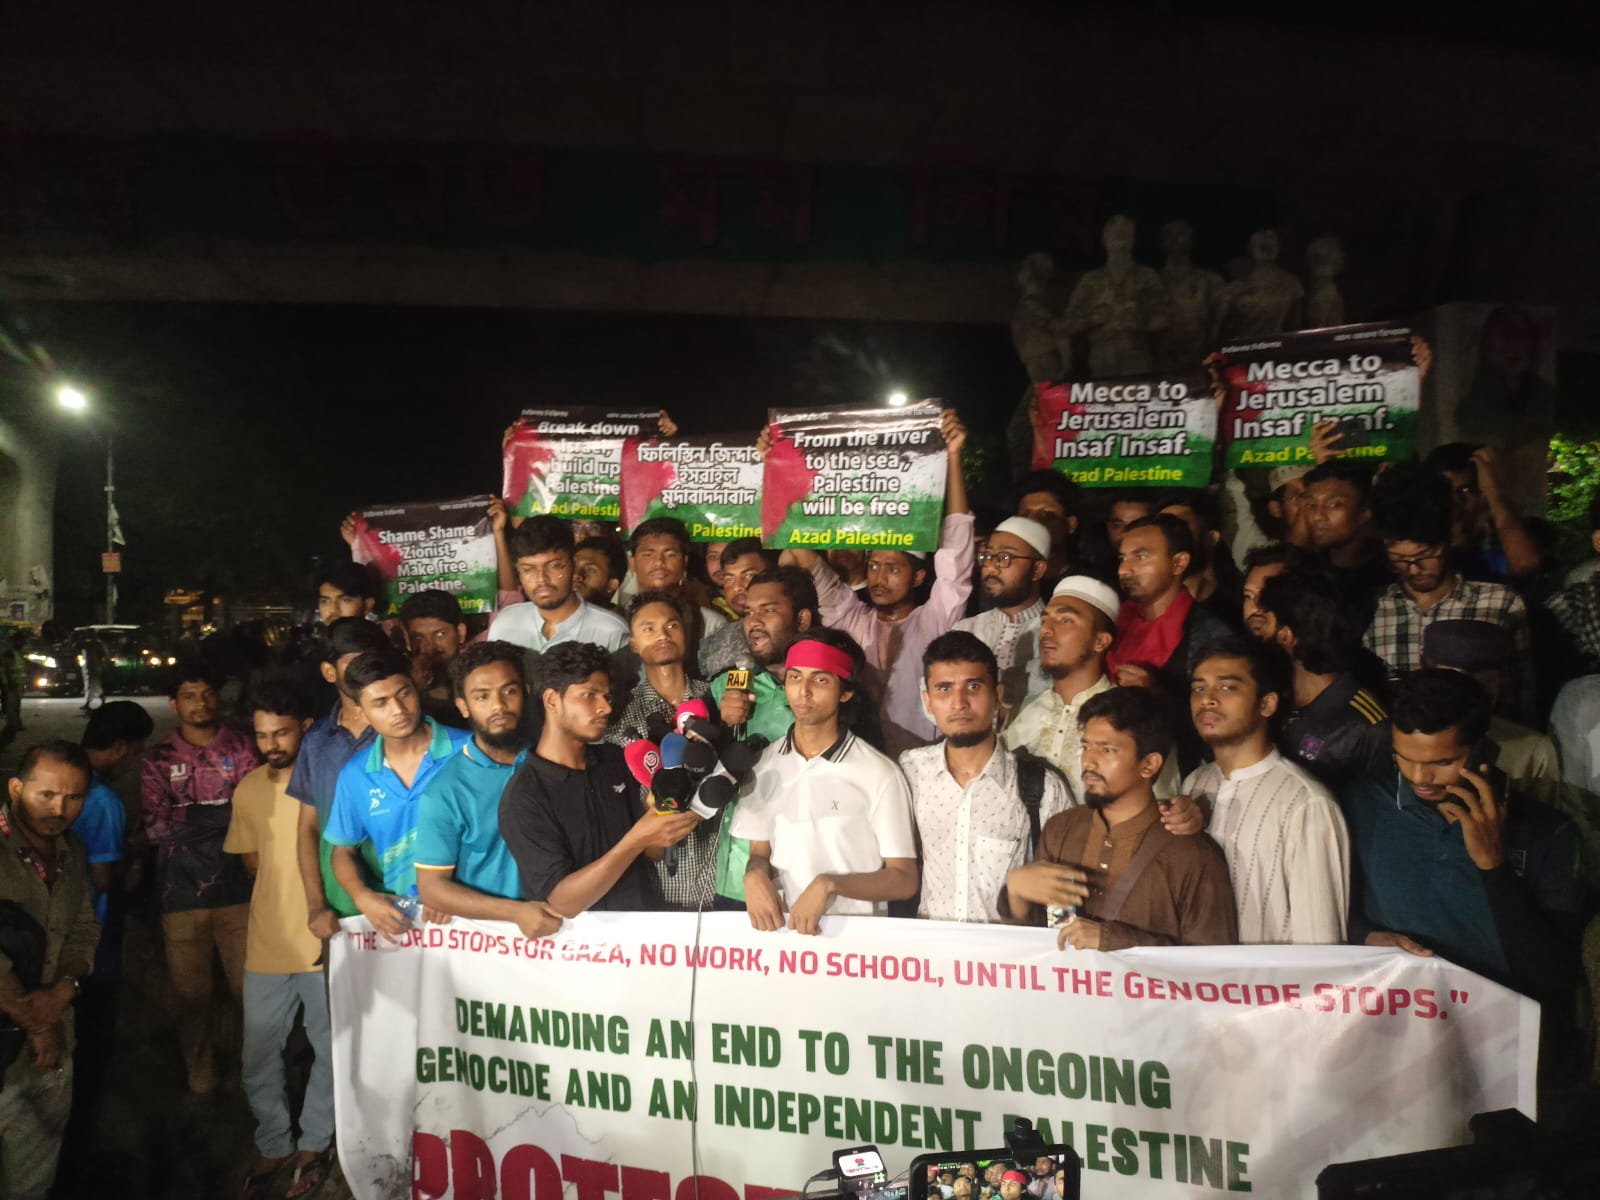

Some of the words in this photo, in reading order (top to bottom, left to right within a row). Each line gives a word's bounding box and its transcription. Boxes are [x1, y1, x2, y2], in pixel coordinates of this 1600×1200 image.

[1247, 358, 1341, 382] Mecca
[1348, 354, 1383, 373] to
[1070, 382, 1150, 403] Mecca
[1158, 381, 1187, 400] to
[1236, 382, 1384, 410] Jerusalem
[537, 421, 586, 433] Break
[590, 421, 639, 435] down
[1056, 407, 1185, 430] Jerusalem
[1234, 412, 1305, 439] Insaf
[793, 431, 842, 448] From
[846, 429, 878, 447] the
[882, 429, 931, 445] river
[1055, 435, 1116, 458] Insaf
[1120, 432, 1193, 456] Insaf.
[637, 443, 705, 462] ফিলিস্তিন
[805, 455, 826, 470] to
[829, 451, 861, 470] the
[1240, 448, 1291, 463] Azad
[550, 457, 594, 474] build
[599, 461, 620, 478] up
[679, 463, 739, 484] ইসরাইল
[1103, 465, 1183, 481] Palestine
[812, 473, 900, 492] Palestine
[571, 502, 620, 516] Palesti
[802, 496, 835, 515] will
[841, 497, 865, 515] be
[870, 496, 910, 515] free
[378, 529, 426, 544] Shame
[428, 525, 475, 541] Shame
[692, 523, 762, 538] Palestine
[789, 529, 831, 544] Azad
[835, 528, 914, 545] Palestine
[403, 542, 457, 560] Zionist,
[397, 561, 436, 577] Make
[438, 559, 467, 574] free
[400, 927, 444, 949] ORLD
[448, 929, 510, 956] STOPS
[513, 936, 556, 961] FOR
[561, 939, 632, 968] GAZA,
[640, 943, 677, 967] NO
[684, 945, 769, 976] WORK,
[779, 949, 818, 975] NO
[826, 951, 945, 987] SCHOOL,
[953, 959, 1047, 991] UNTIL
[1052, 966, 1113, 998] THE
[1123, 971, 1304, 1010] GENOCIDE
[1313, 982, 1469, 1020] STOPS."
[455, 997, 630, 1055] DEMANDING
[645, 1018, 694, 1060] AN
[711, 1023, 782, 1068] END
[798, 1029, 850, 1075] TO
[868, 1035, 943, 1085] THE
[963, 1043, 1171, 1109] ONGOING
[416, 1047, 551, 1101] GENOCIDE
[565, 1068, 632, 1112] AND
[648, 1078, 697, 1122] AN
[714, 1083, 982, 1153] INDEPENDENT
